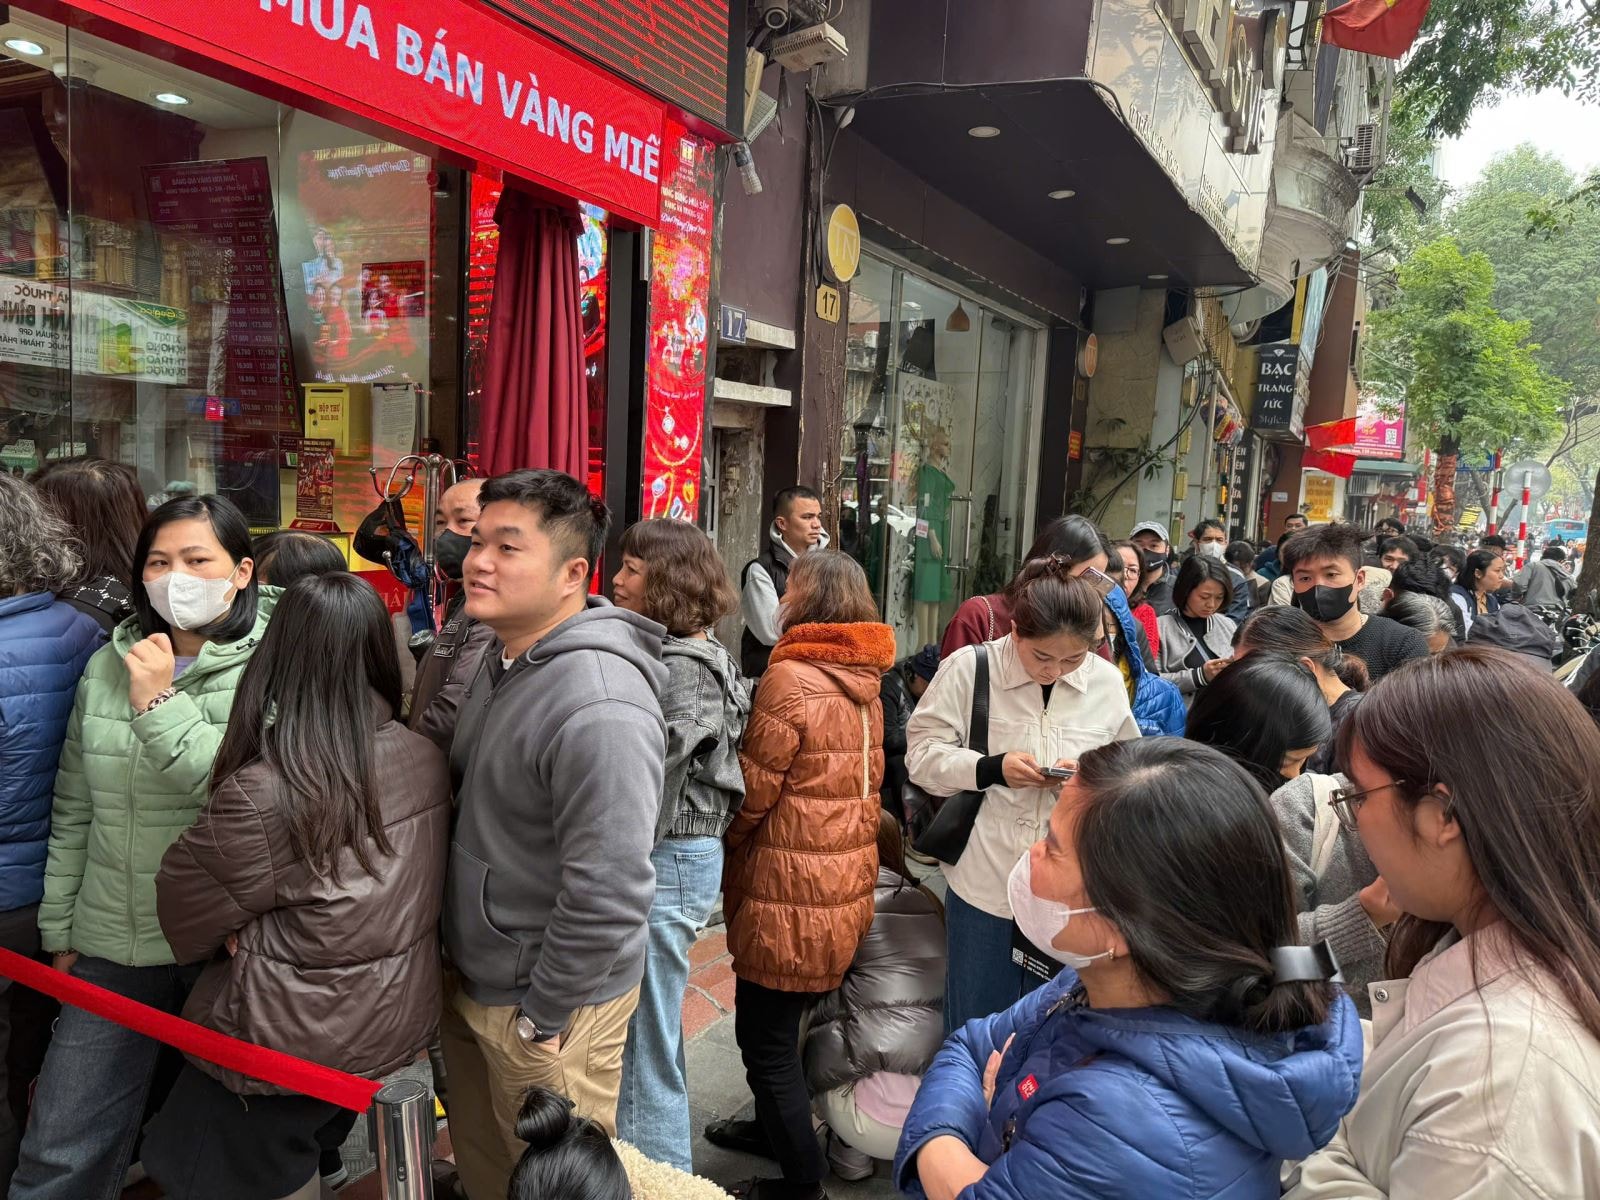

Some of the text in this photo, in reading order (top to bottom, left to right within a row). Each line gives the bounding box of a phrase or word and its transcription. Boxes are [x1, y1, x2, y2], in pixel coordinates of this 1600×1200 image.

[395, 23, 485, 106] BÁN
[496, 72, 594, 154] VÀNG
[822, 291, 837, 316] 17
[727, 310, 745, 338] 17
[1261, 362, 1294, 379] BẠC
[1257, 383, 1293, 393] TRANG
[1263, 398, 1284, 409] SỨC
